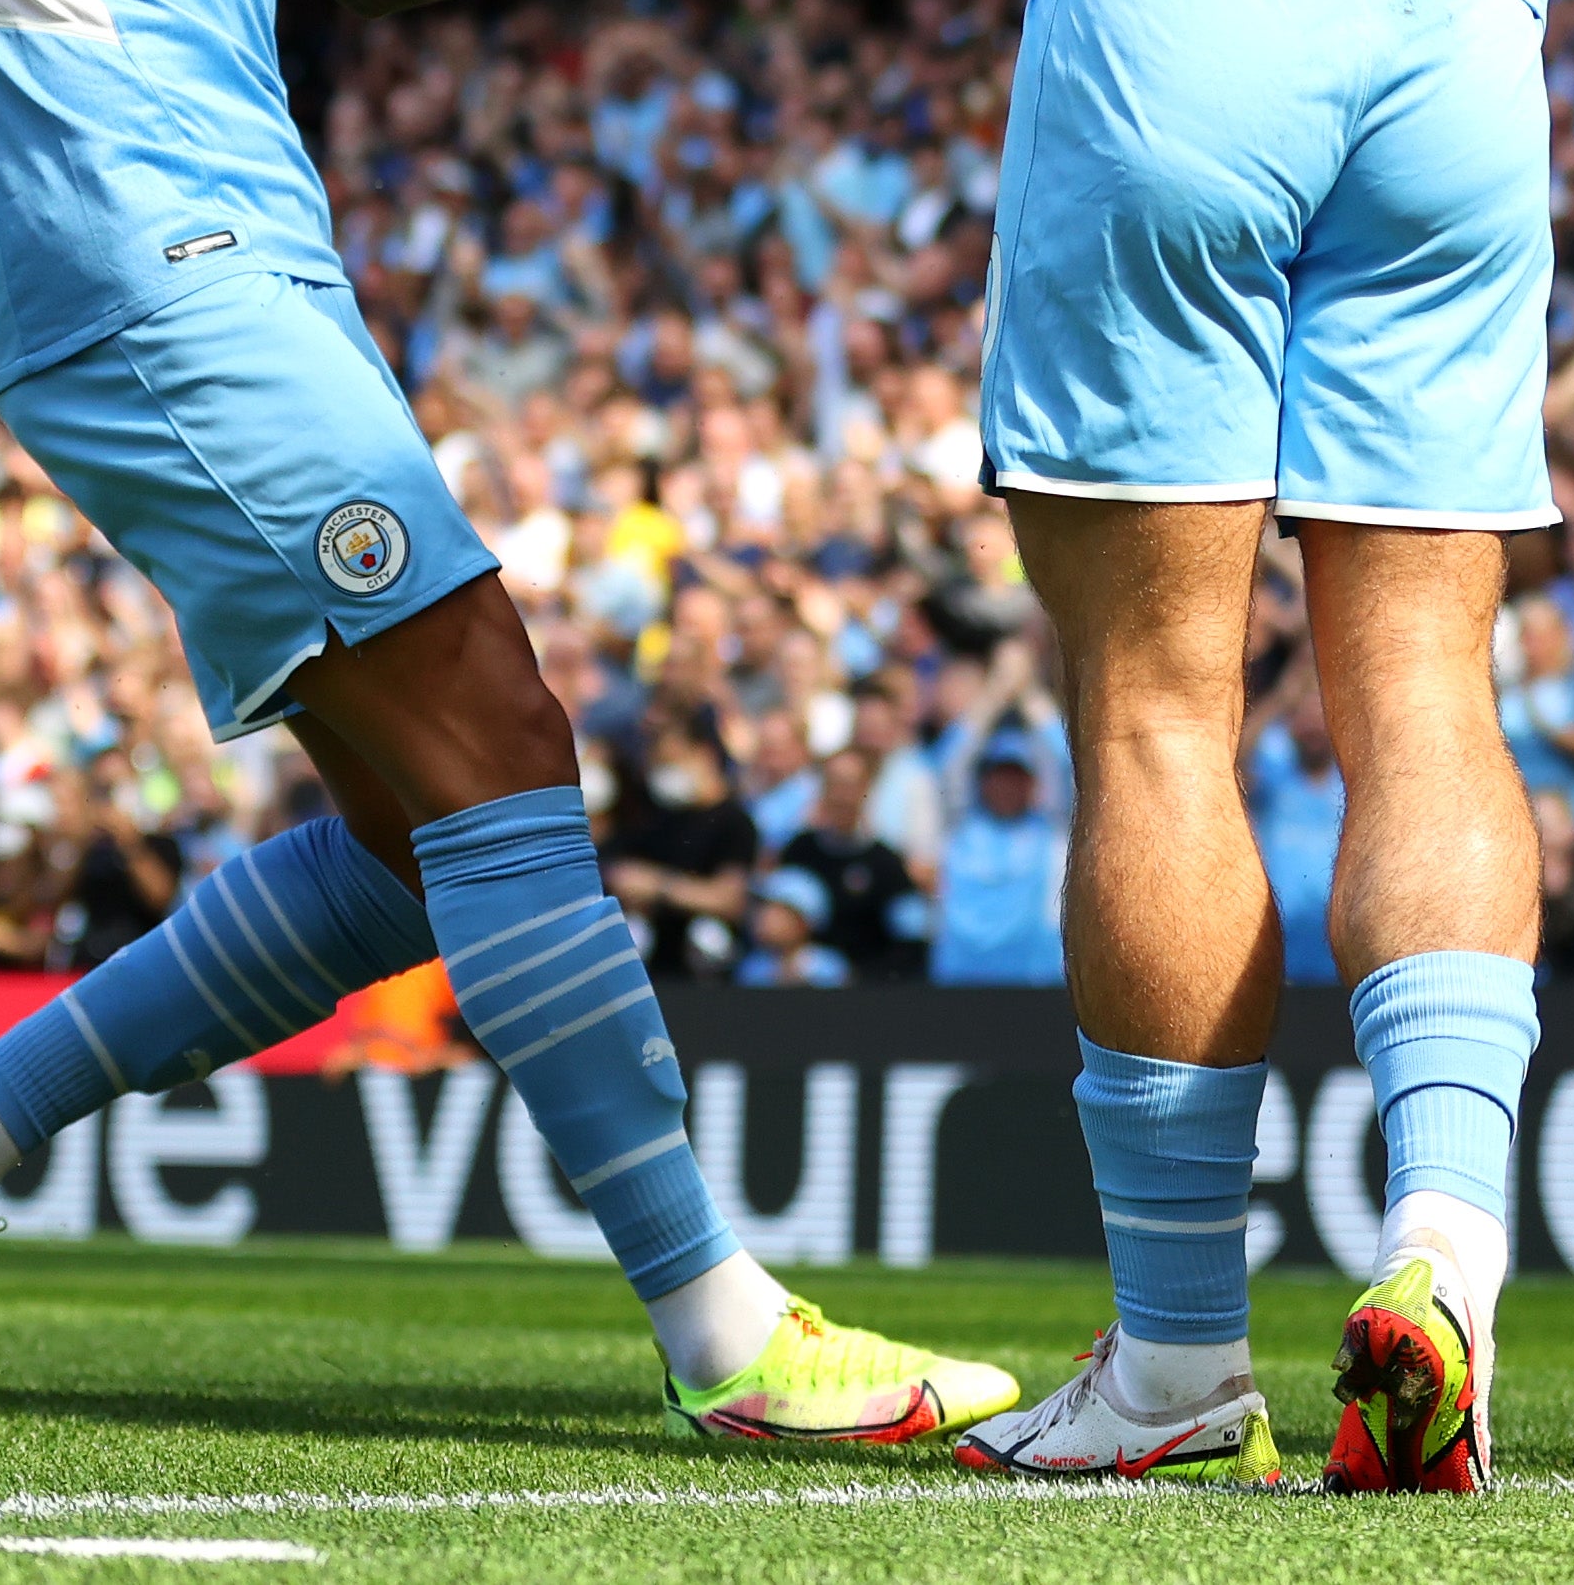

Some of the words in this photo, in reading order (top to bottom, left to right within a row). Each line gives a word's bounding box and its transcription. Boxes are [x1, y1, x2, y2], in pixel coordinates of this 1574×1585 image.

[321, 507, 388, 554] MANCHESTER
[365, 570, 392, 590] CITY
[1222, 1430, 1237, 1443] 10
[1032, 1453, 1090, 1468] PHANTOM
